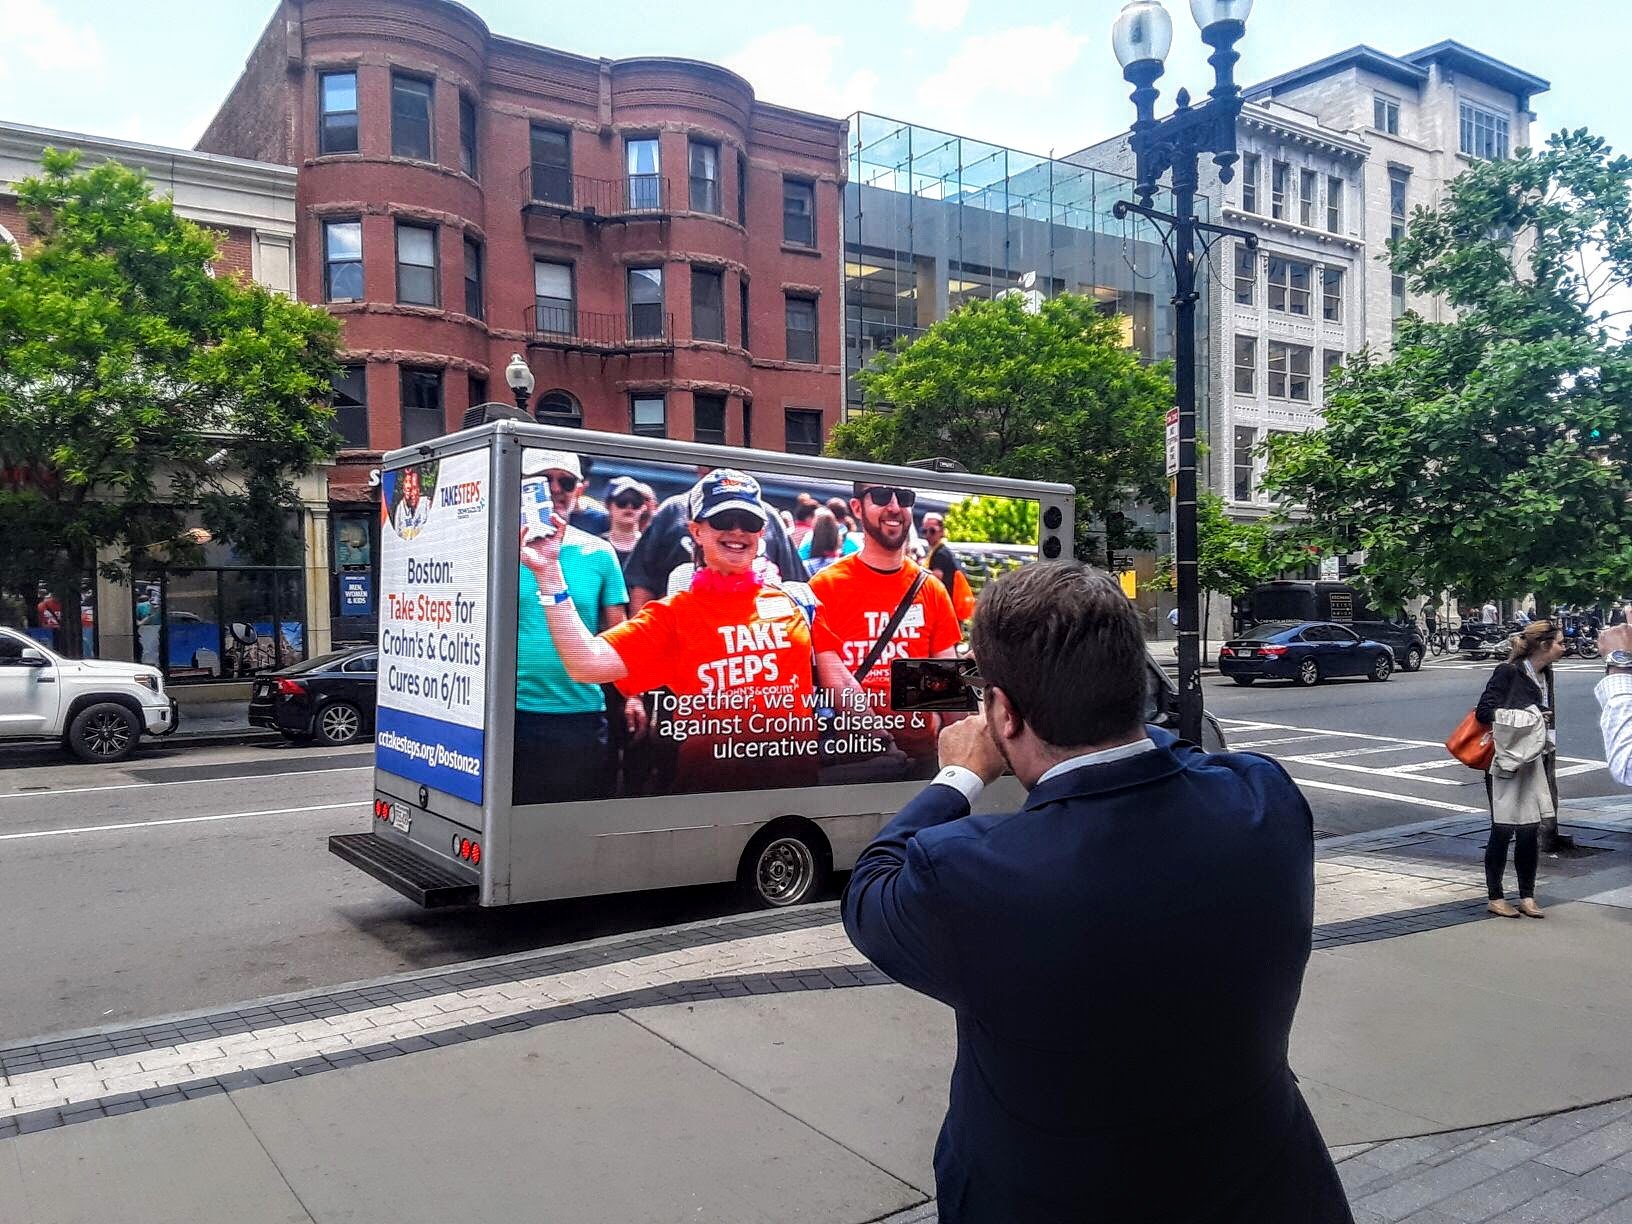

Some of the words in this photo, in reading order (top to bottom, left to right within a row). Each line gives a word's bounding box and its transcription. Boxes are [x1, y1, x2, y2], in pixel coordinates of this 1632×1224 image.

[408, 557, 453, 584] Boston:
[388, 592, 415, 620] Take
[417, 594, 452, 630] Steps
[455, 592, 475, 624] for
[382, 628, 424, 659] Crohn's
[427, 632, 435, 660] &
[439, 632, 480, 666] Colitis
[717, 622, 792, 654] TAKE
[388, 665, 420, 696] Cures
[423, 676, 438, 699] on
[441, 672, 470, 709] 6/11!
[697, 653, 779, 694] STEPS
[648, 690, 757, 715] Together,
[763, 694, 794, 709] we
[801, 688, 835, 708] will
[841, 687, 887, 712] fight
[660, 714, 742, 740] against
[748, 712, 828, 733] Crohn's
[833, 711, 905, 731] disease
[911, 711, 926, 728] &
[378, 731, 480, 776] cctakesteps.org/Boston22
[713, 737, 818, 759] ulcerative
[824, 734, 887, 754] colitis.
